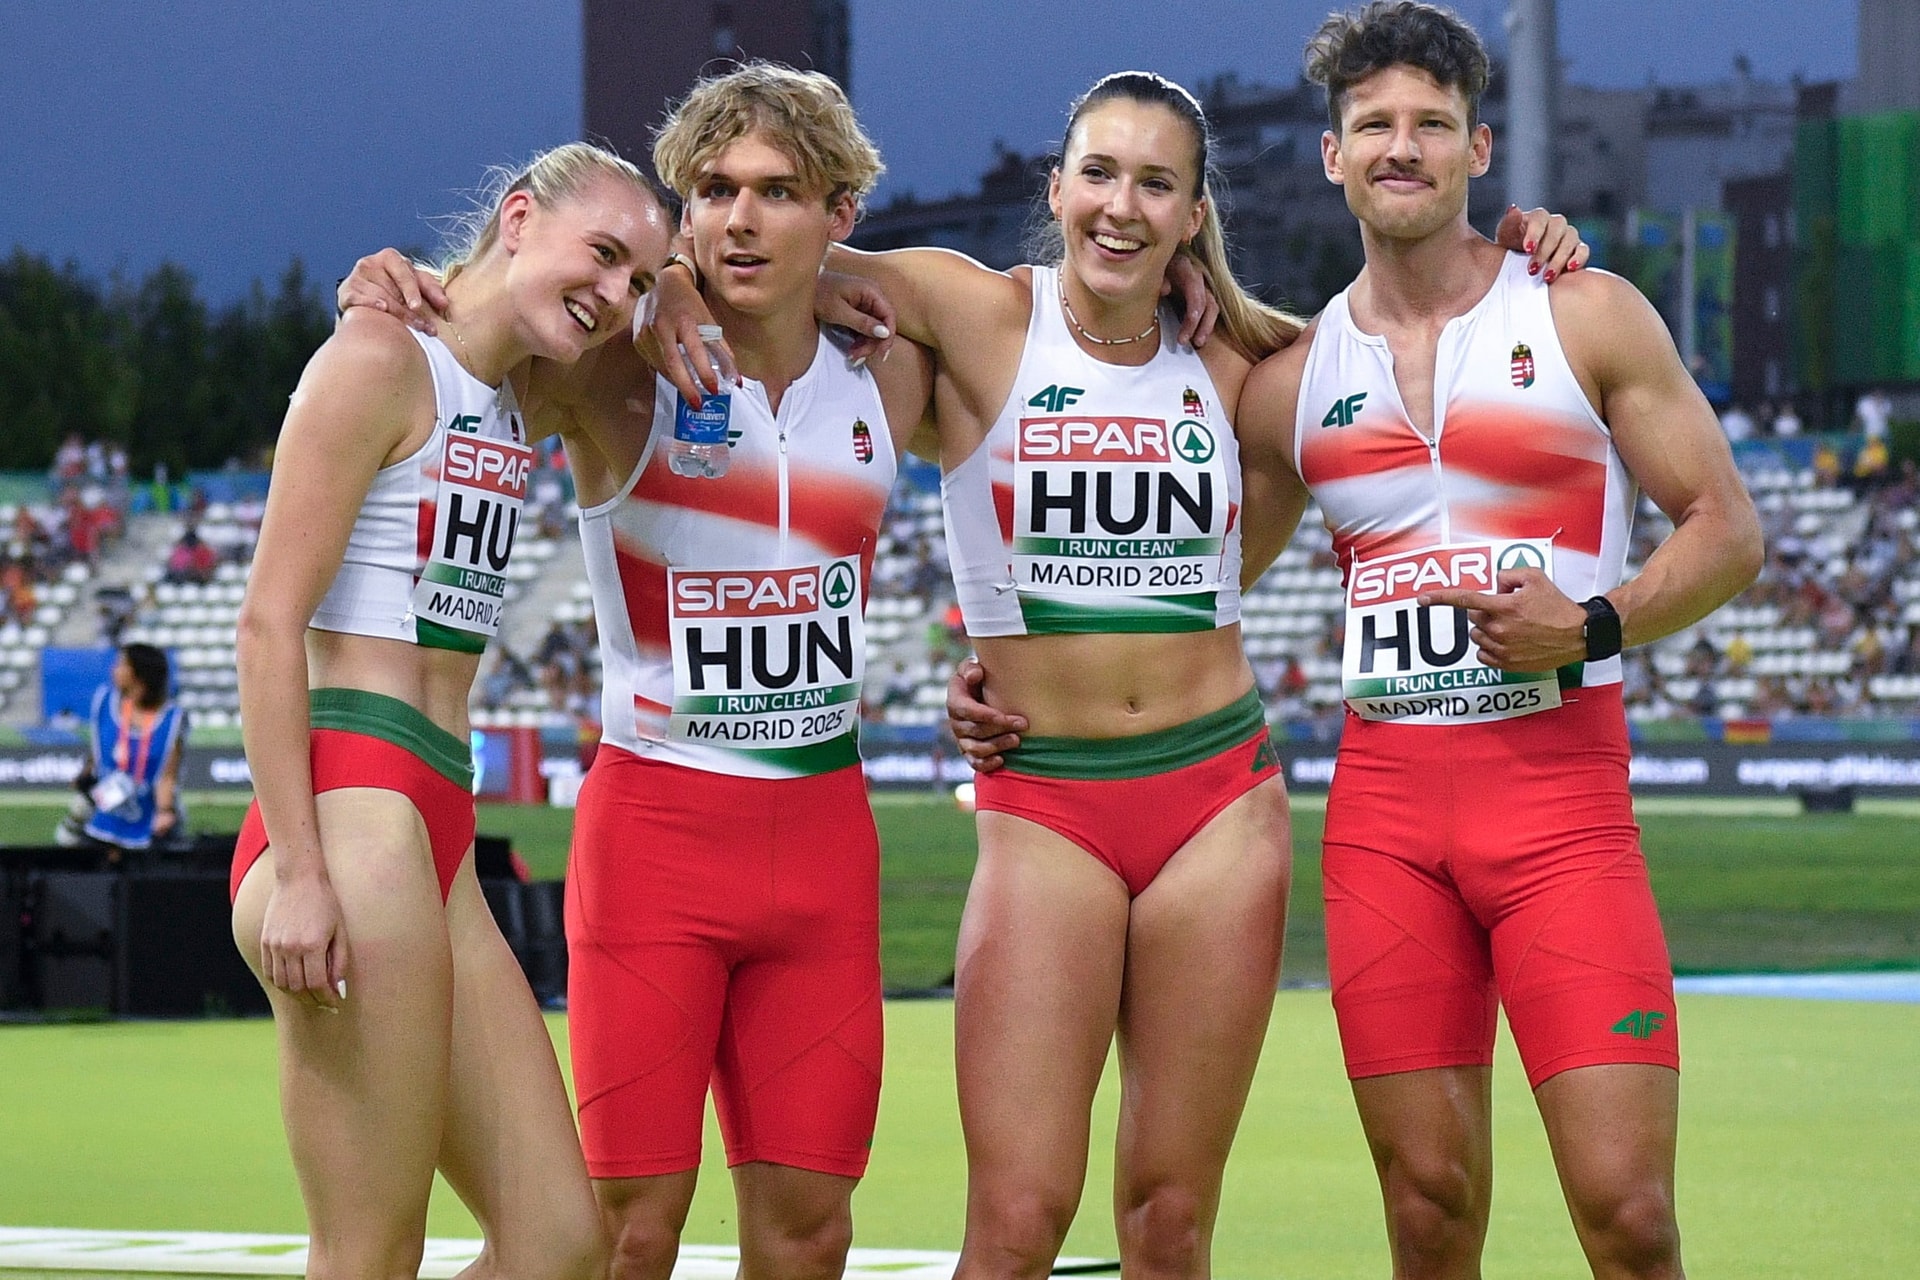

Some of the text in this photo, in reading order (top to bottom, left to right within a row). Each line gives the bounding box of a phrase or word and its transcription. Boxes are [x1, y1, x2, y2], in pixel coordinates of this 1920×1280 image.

[1028, 384, 1085, 412] 4F
[1321, 392, 1368, 428] 4F
[1023, 422, 1167, 457] SPAR
[1030, 471, 1213, 535] HUN
[444, 493, 522, 571] HU
[1059, 540, 1064, 555] I
[1069, 541, 1111, 556] RUN
[459, 570, 506, 595] I RUN CLE
[1031, 563, 1204, 587] MADRID 2025
[1354, 553, 1488, 601] SPAR
[428, 591, 493, 625] MADRID
[677, 573, 817, 612] SPAR
[686, 616, 853, 690] HUN
[1359, 605, 1470, 674] HU
[1386, 668, 1502, 694] I RUN CLEAN
[718, 697, 723, 712] I
[727, 696, 767, 712] RUN
[1366, 687, 1541, 717] MADRID 2025
[687, 709, 846, 741] MADRID 2025
[1610, 1009, 1667, 1039] 4F
